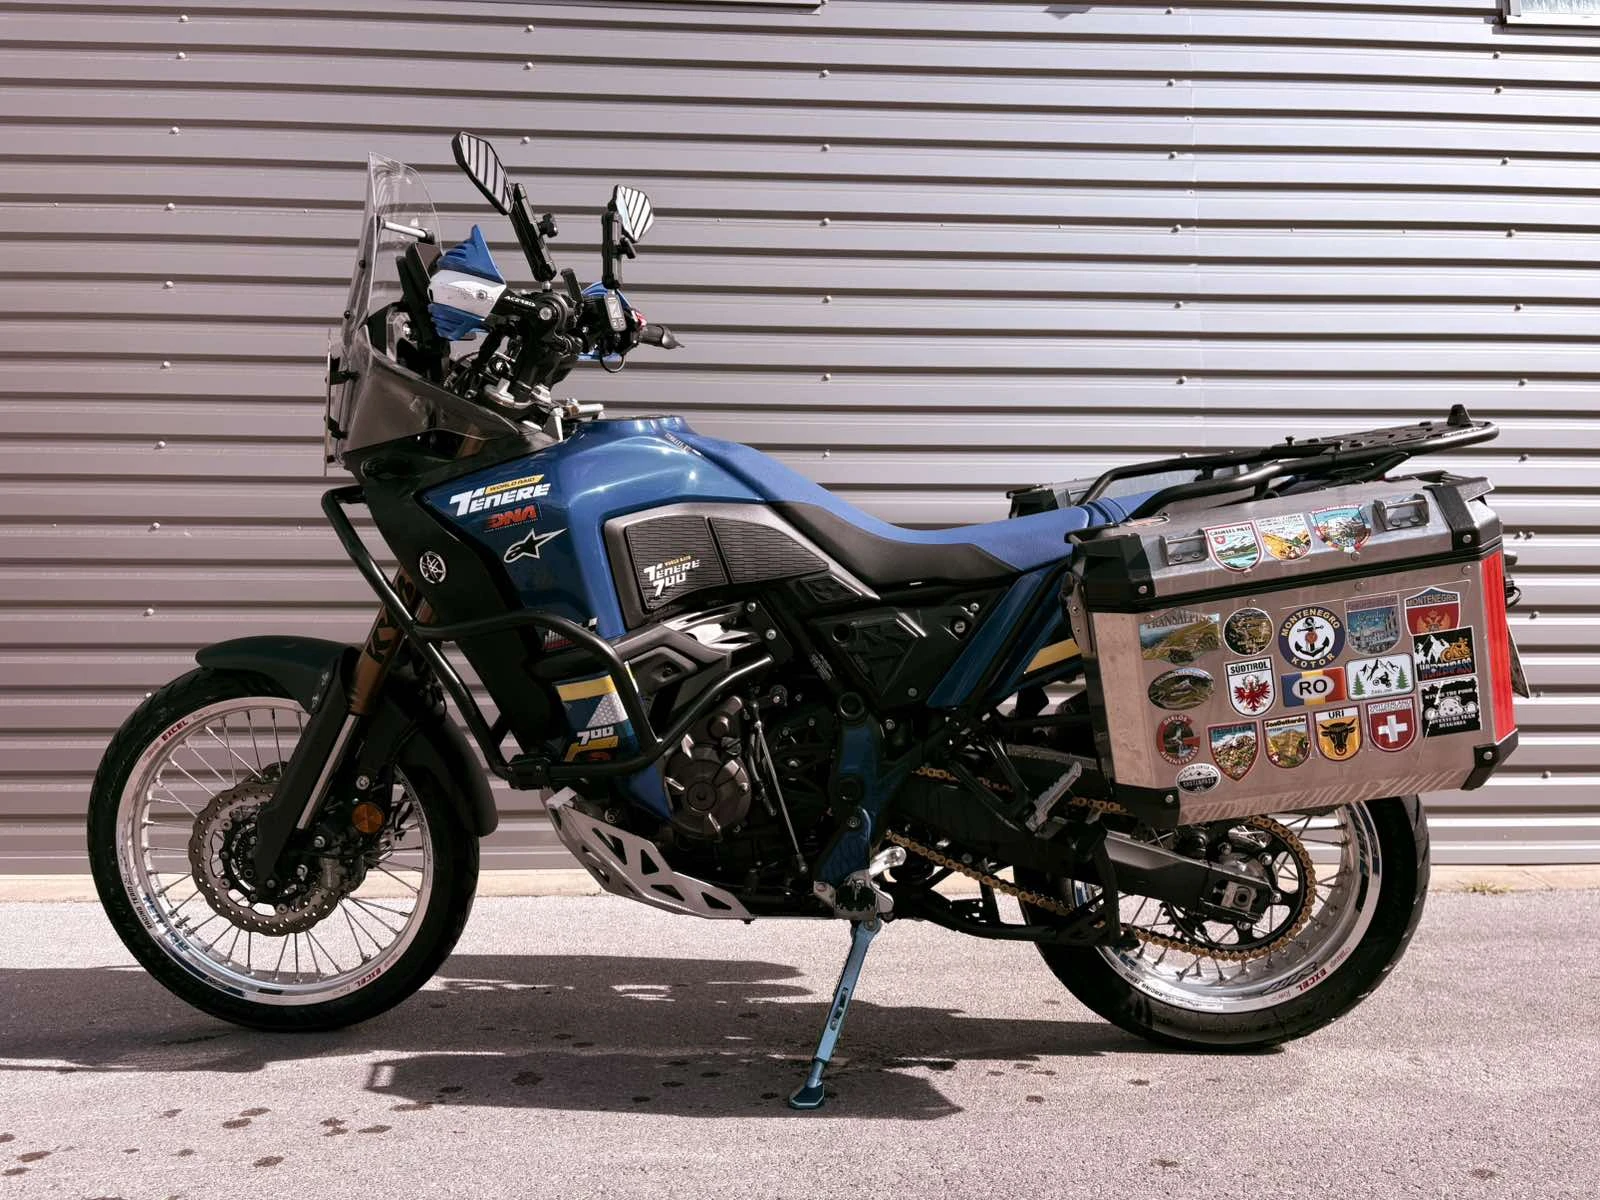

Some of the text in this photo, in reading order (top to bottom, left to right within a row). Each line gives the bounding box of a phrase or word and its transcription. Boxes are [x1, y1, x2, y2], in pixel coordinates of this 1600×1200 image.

[653, 572, 686, 597] 700
[1406, 594, 1457, 606] MONTENEGRO
[1281, 609, 1340, 637] MONTENEGRO
[1291, 652, 1335, 668] KOTOR
[1299, 680, 1328, 696] RO
[1328, 710, 1345, 719] URI
[161, 720, 188, 741] EXCEL
[576, 726, 614, 746] 700
[127, 886, 140, 904] TEAM
[135, 906, 154, 930] RACING
[354, 967, 381, 987] EXCEL
[1296, 967, 1327, 992] EXCEL
